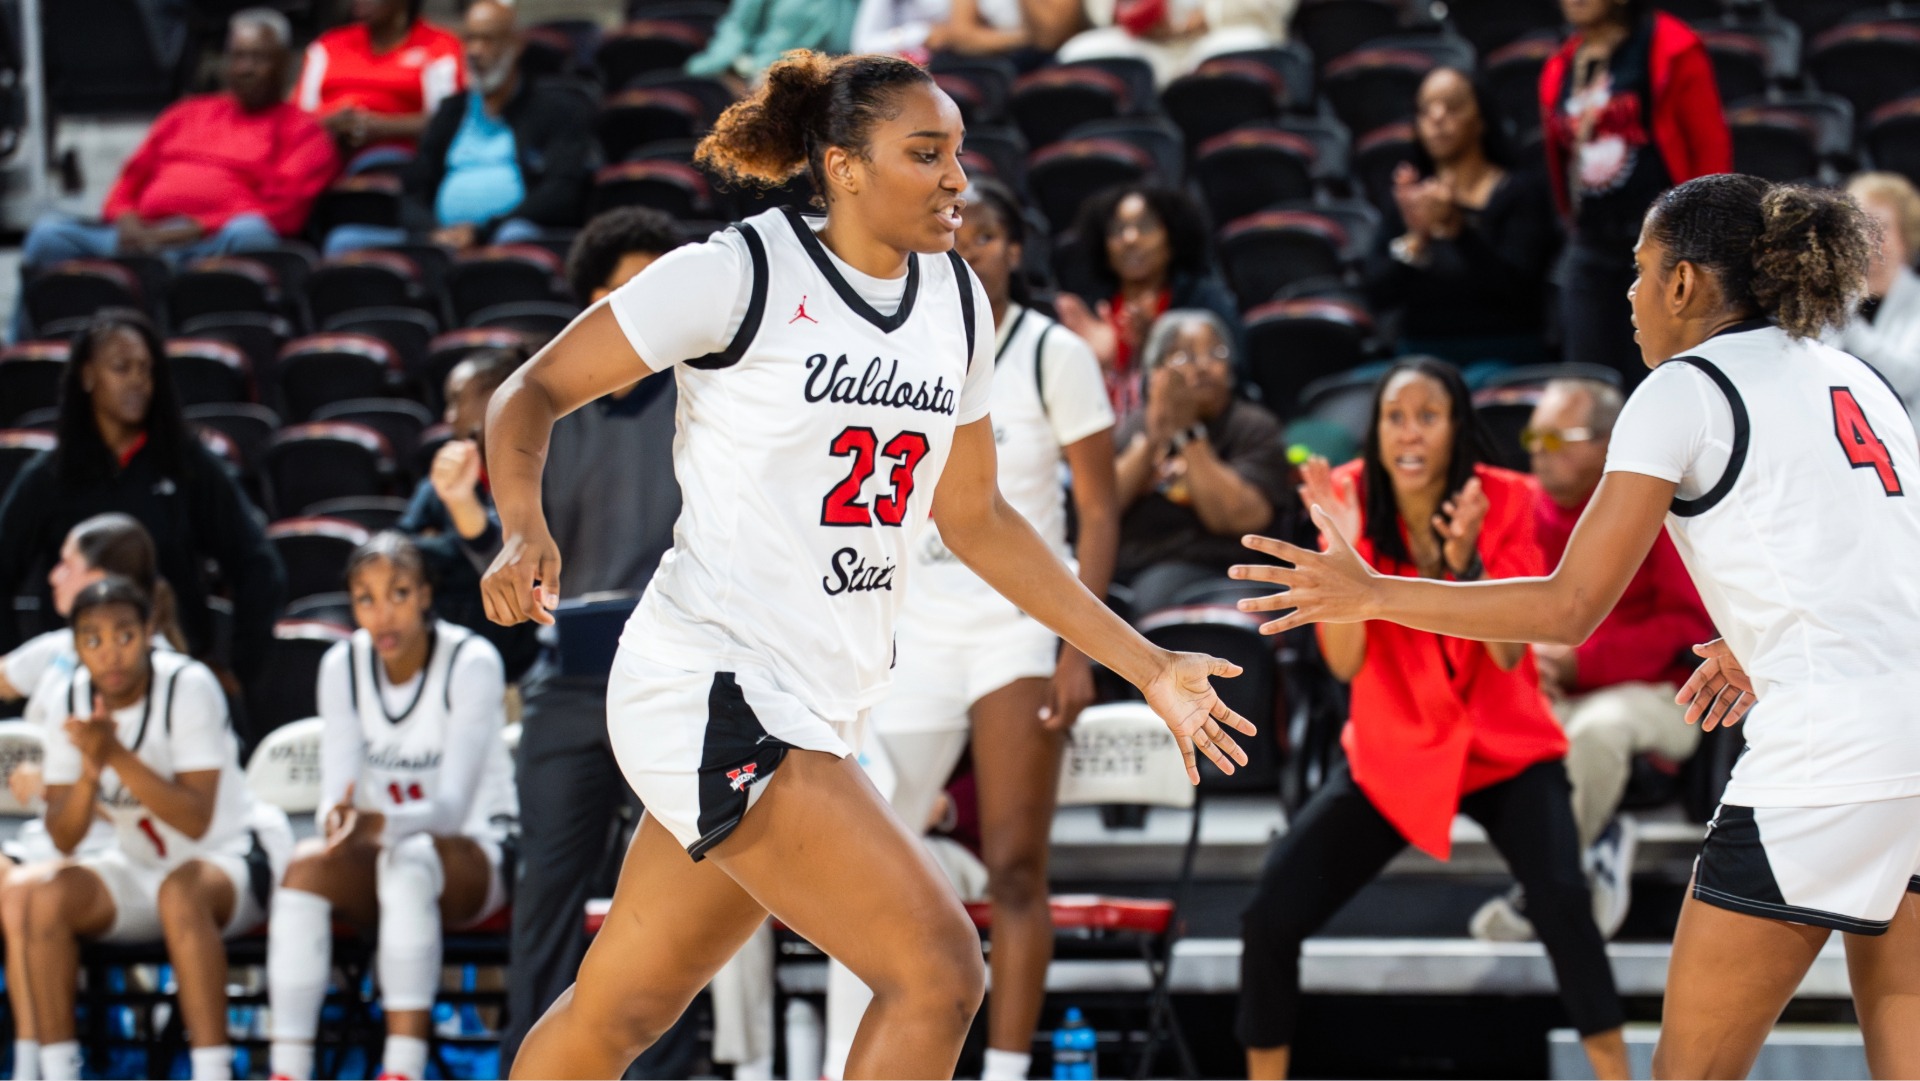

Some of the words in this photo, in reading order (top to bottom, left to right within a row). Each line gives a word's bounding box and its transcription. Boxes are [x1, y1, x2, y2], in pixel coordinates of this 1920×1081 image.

[804, 353, 955, 416] Valdosta
[820, 425, 931, 528] 23
[1829, 386, 1904, 497] 4
